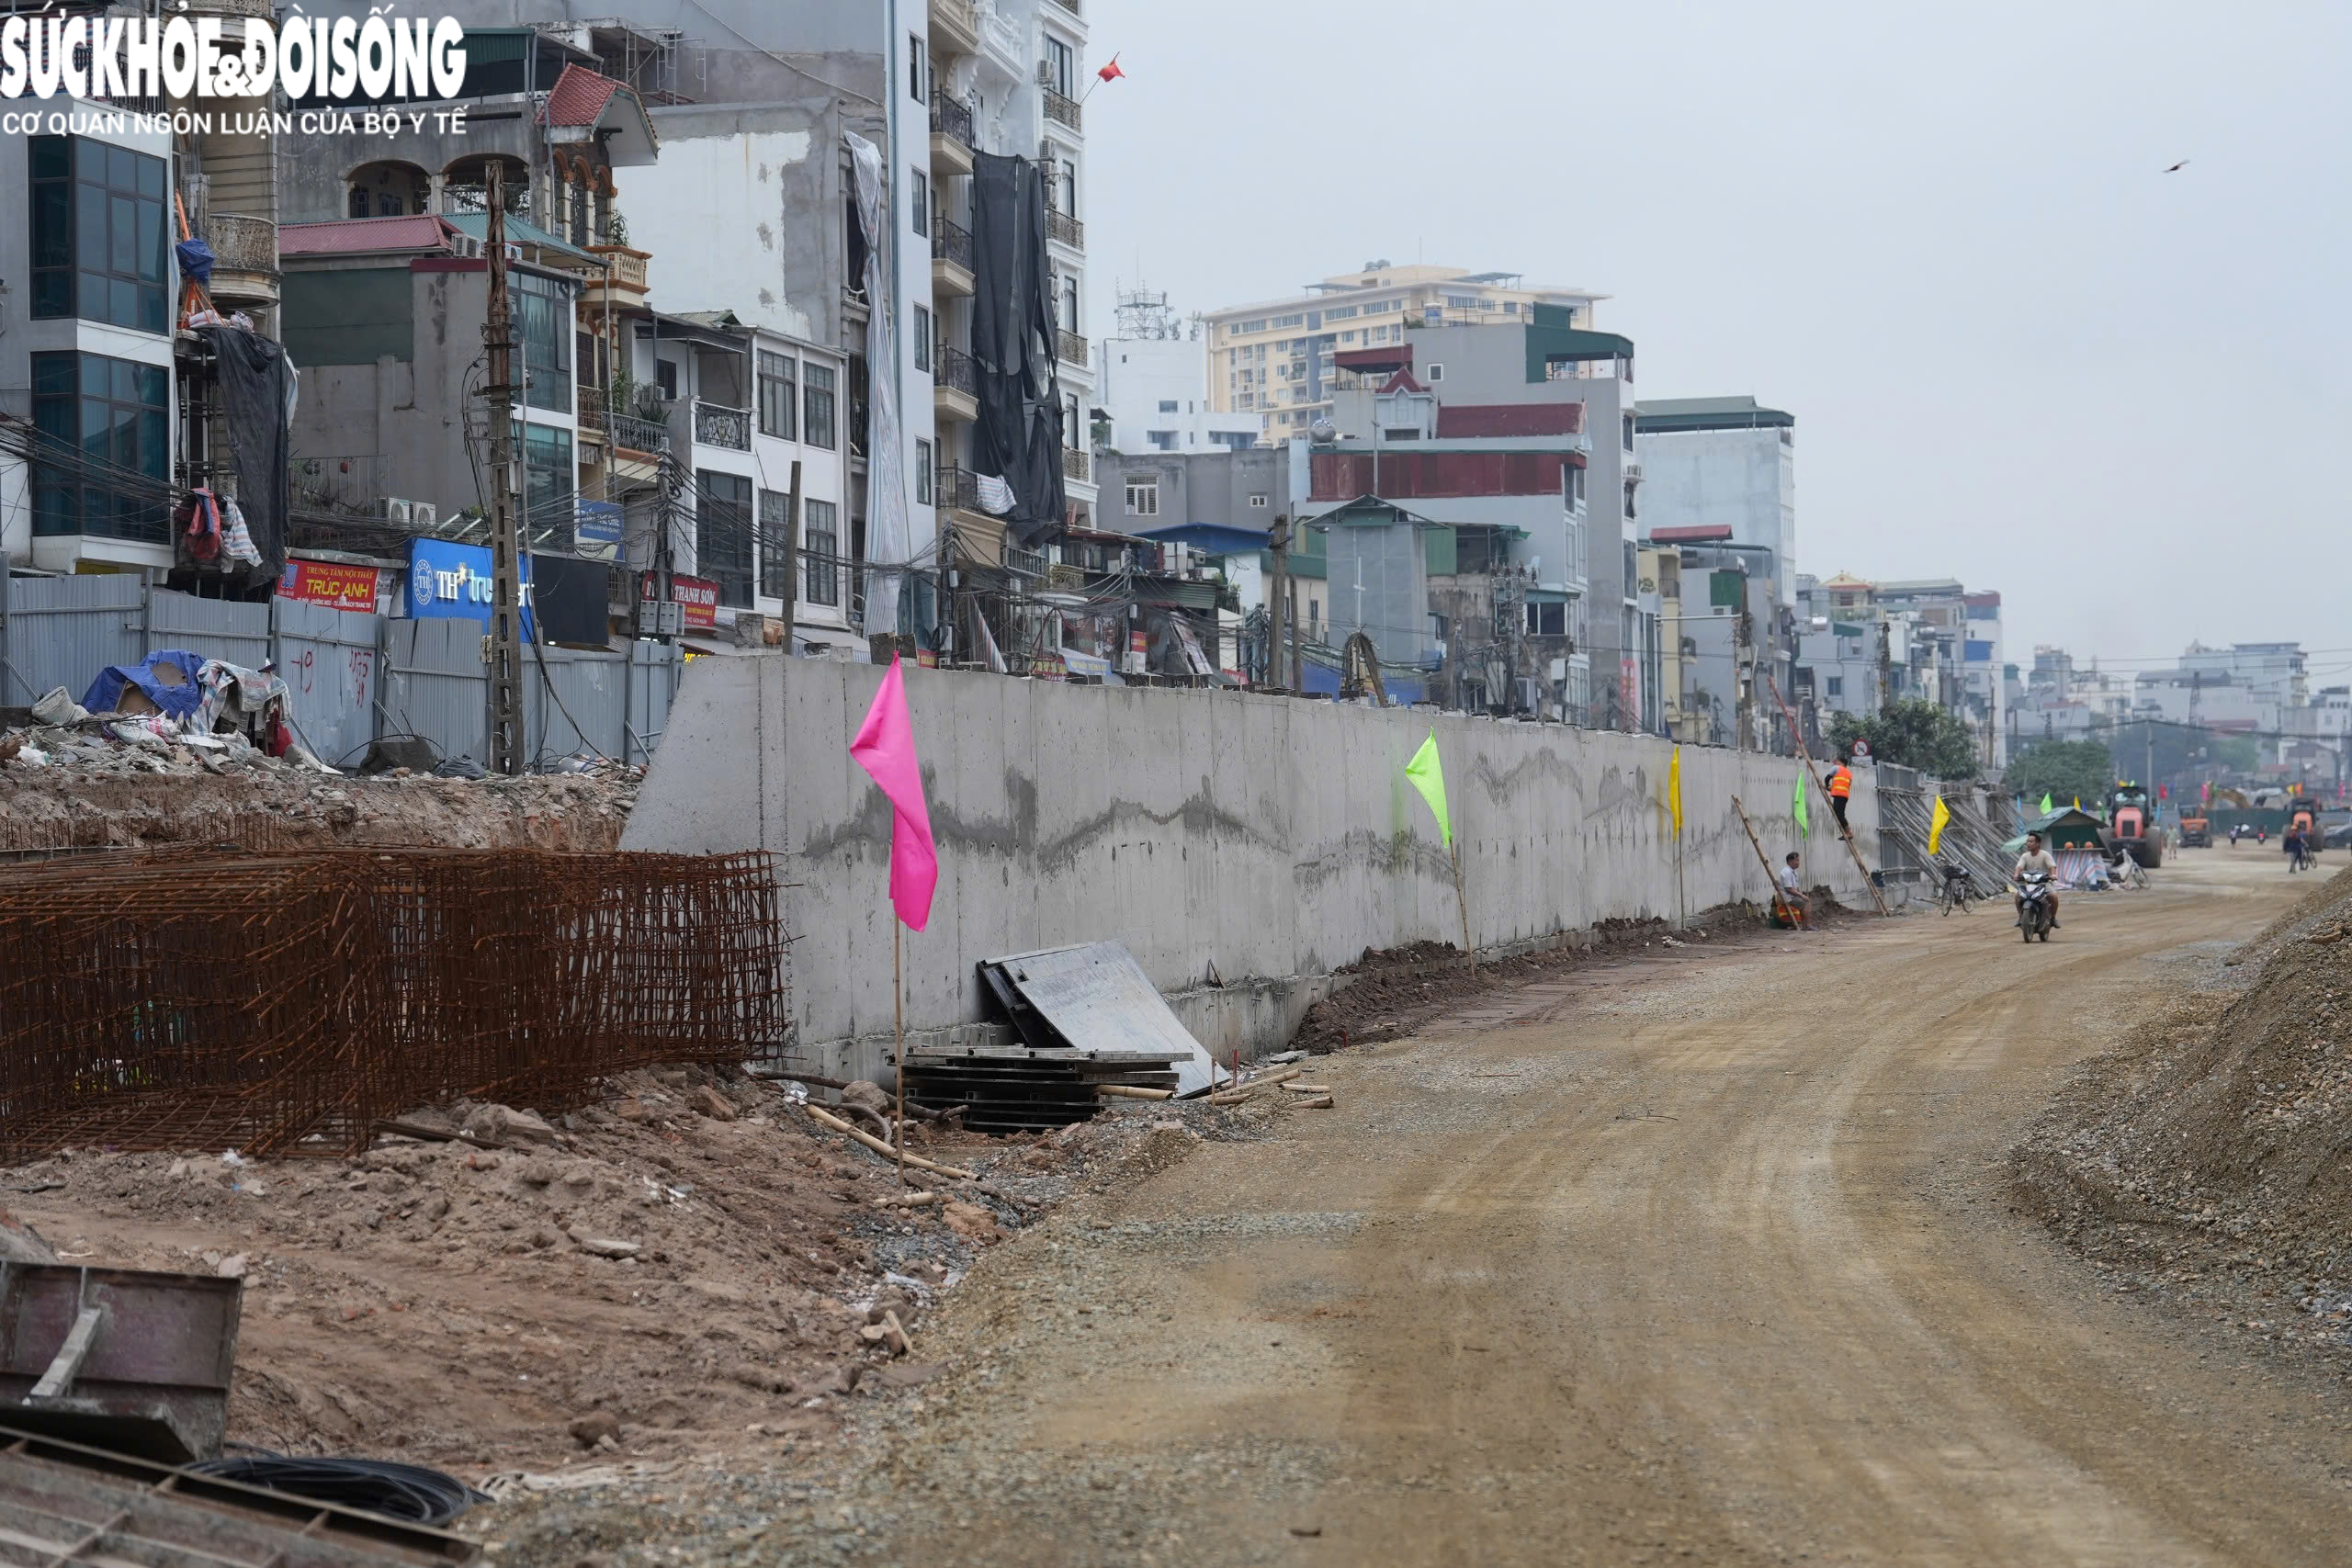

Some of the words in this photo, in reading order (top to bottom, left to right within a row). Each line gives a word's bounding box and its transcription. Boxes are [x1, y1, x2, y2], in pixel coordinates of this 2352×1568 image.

[306, 566, 329, 576] TRUNG
[330, 567, 343, 577] TÂM
[344, 569, 356, 579] NỘI
[306, 577, 340, 596] TRÚC
[343, 582, 369, 598] ANH
[435, 570, 458, 600] TH
[468, 568, 493, 604] tru
[674, 585, 699, 604] THANH
[700, 588, 715, 605] SƠN
